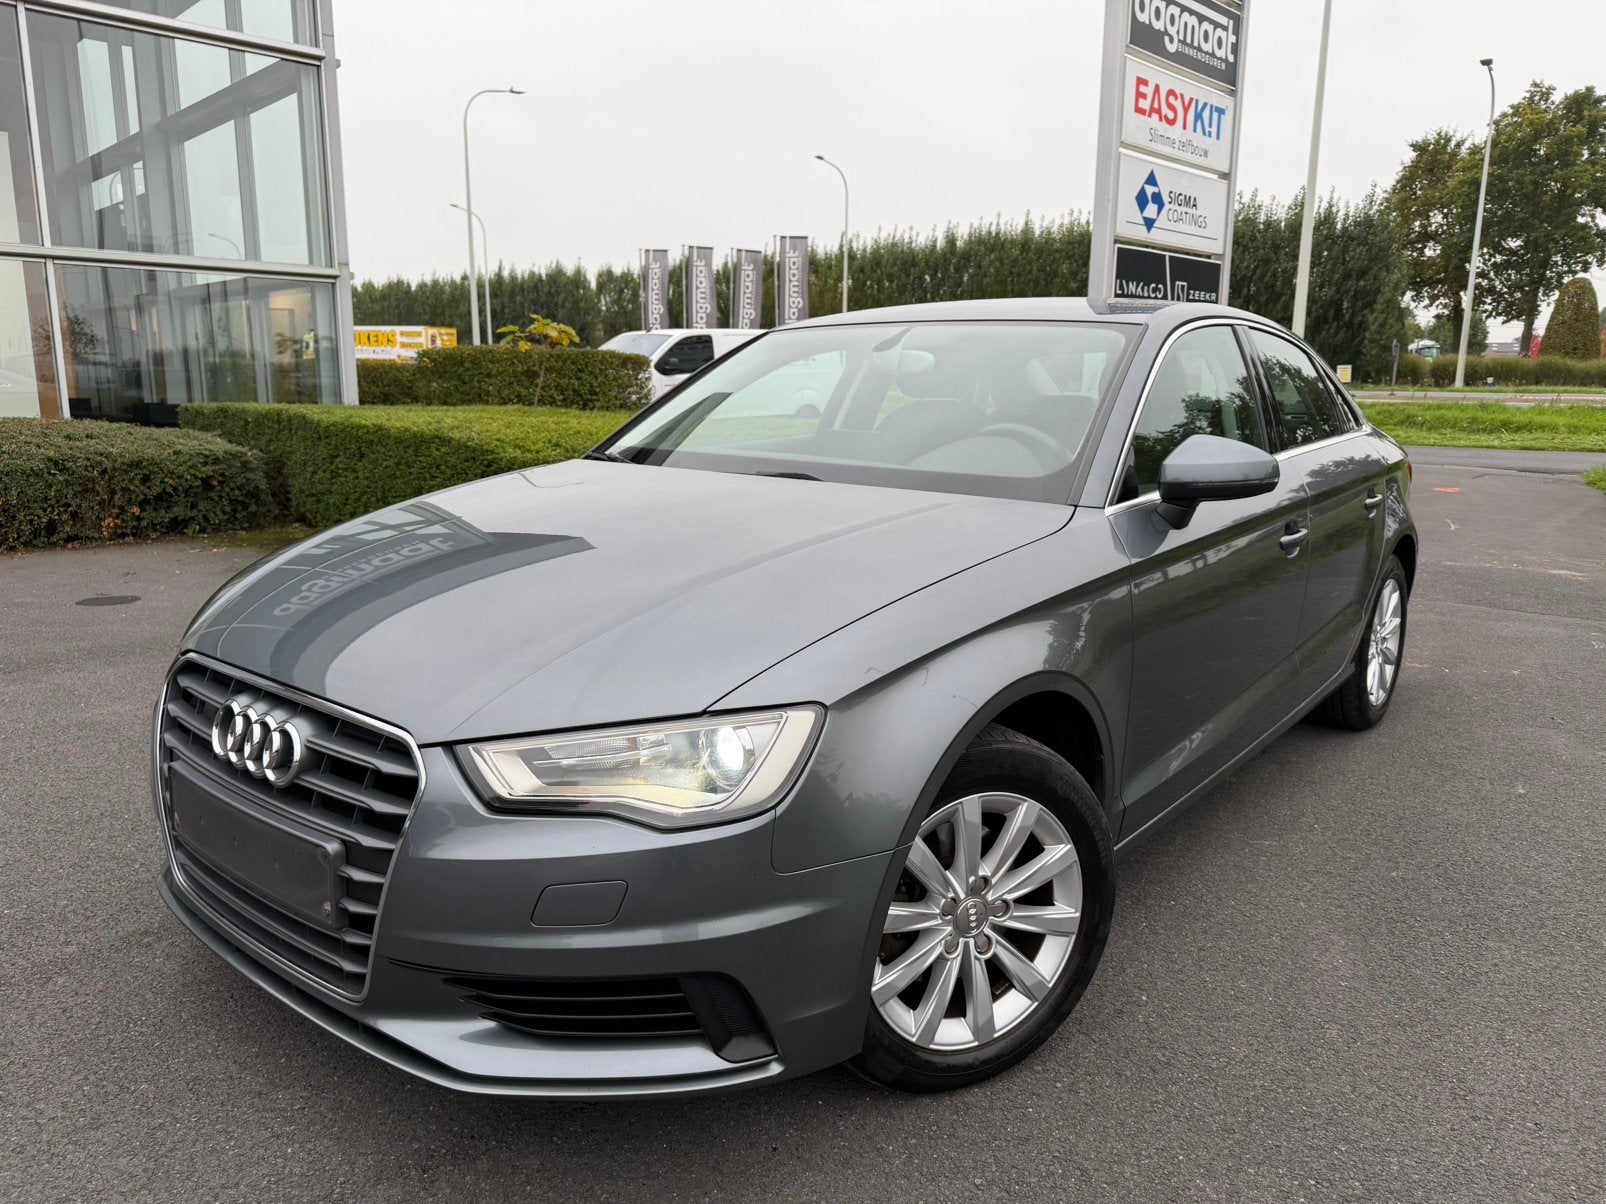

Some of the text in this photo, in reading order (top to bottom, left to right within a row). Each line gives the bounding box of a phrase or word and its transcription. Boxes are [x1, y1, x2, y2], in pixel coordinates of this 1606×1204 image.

[1177, 42, 1226, 70] BINNENDEUREN
[1178, 137, 1209, 159] zelfbouw
[1168, 190, 1198, 210] SIGMA
[1166, 208, 1208, 229] COATINGS
[1188, 290, 1217, 301] ZEEKR
